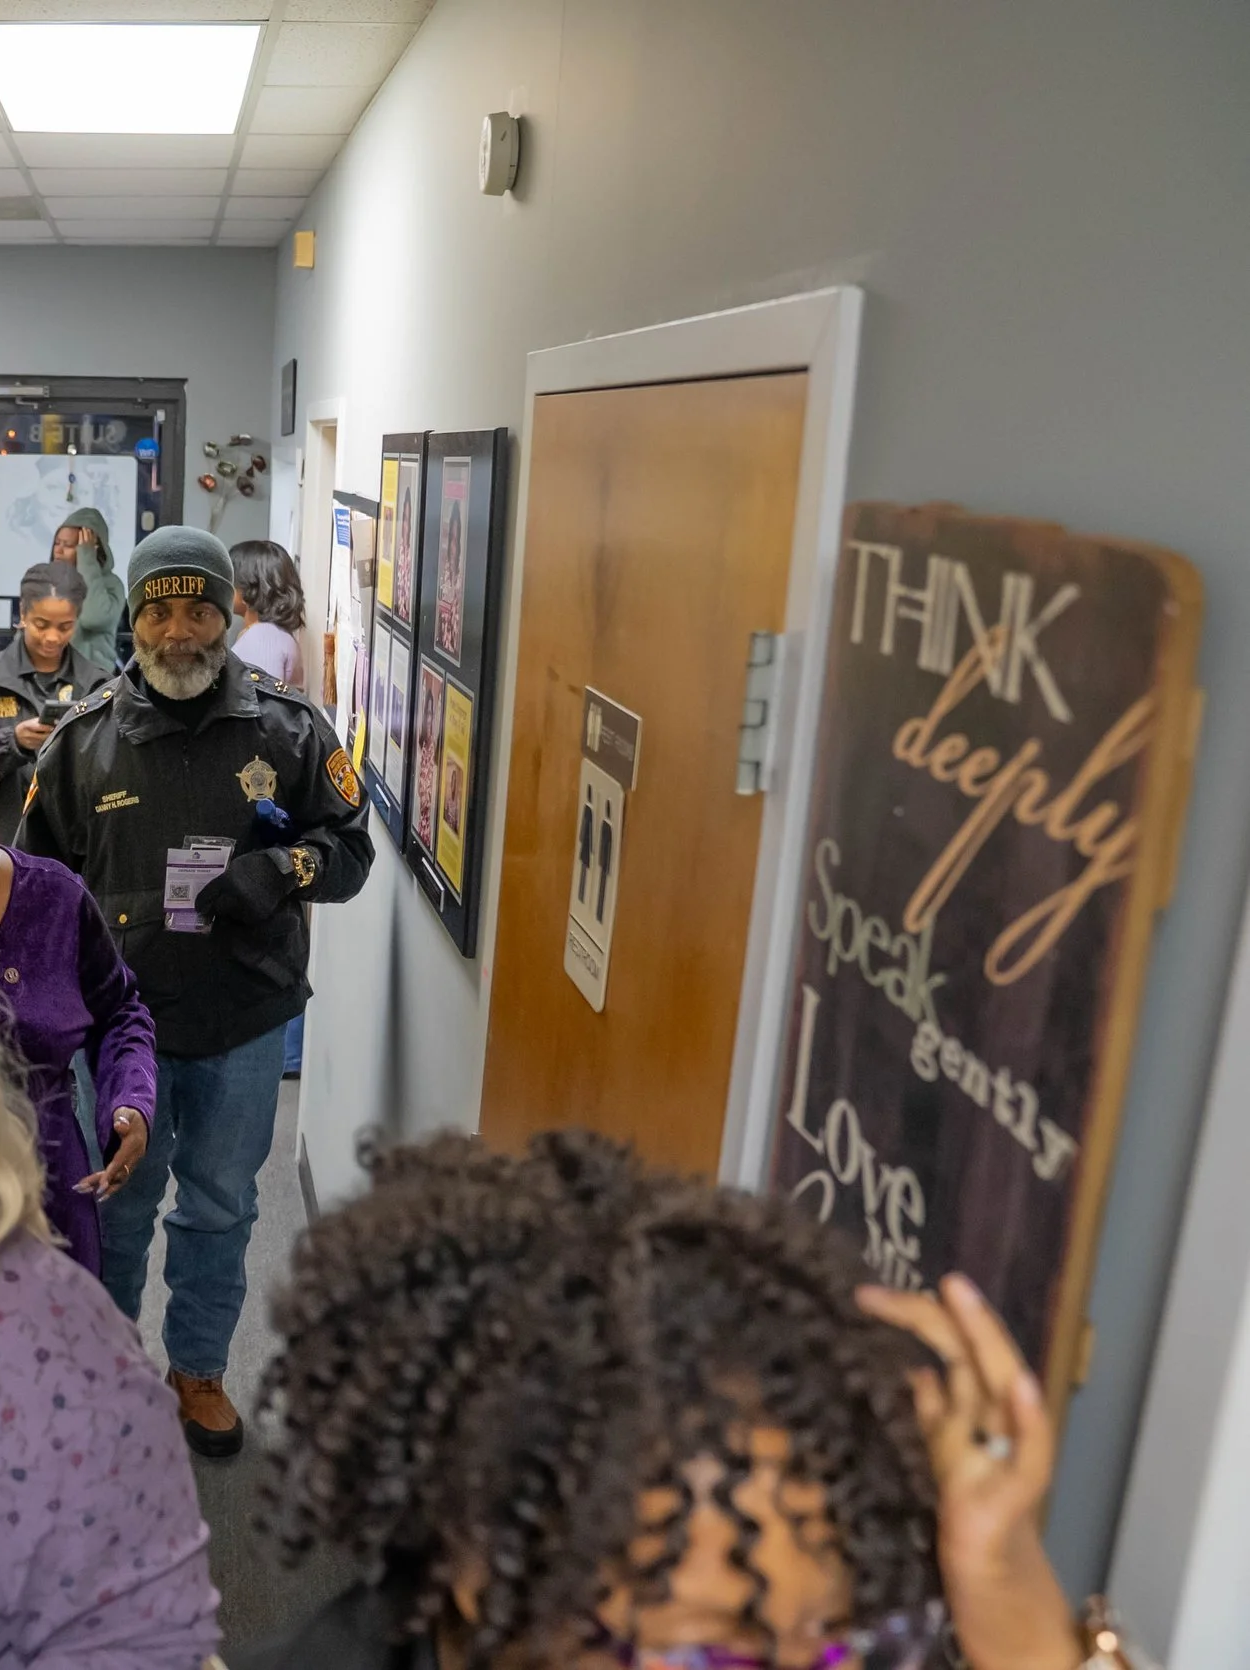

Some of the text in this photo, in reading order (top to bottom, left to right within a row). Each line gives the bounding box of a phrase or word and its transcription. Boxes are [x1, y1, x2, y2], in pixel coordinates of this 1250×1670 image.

[145, 575, 206, 600] SHERIFF
[848, 540, 1081, 724] THINK
[102, 790, 127, 803] SHERIFF
[892, 623, 1153, 986] deeply
[808, 838, 949, 1030] Speak
[786, 984, 926, 1262] Love
[910, 1019, 1077, 1181] gently
